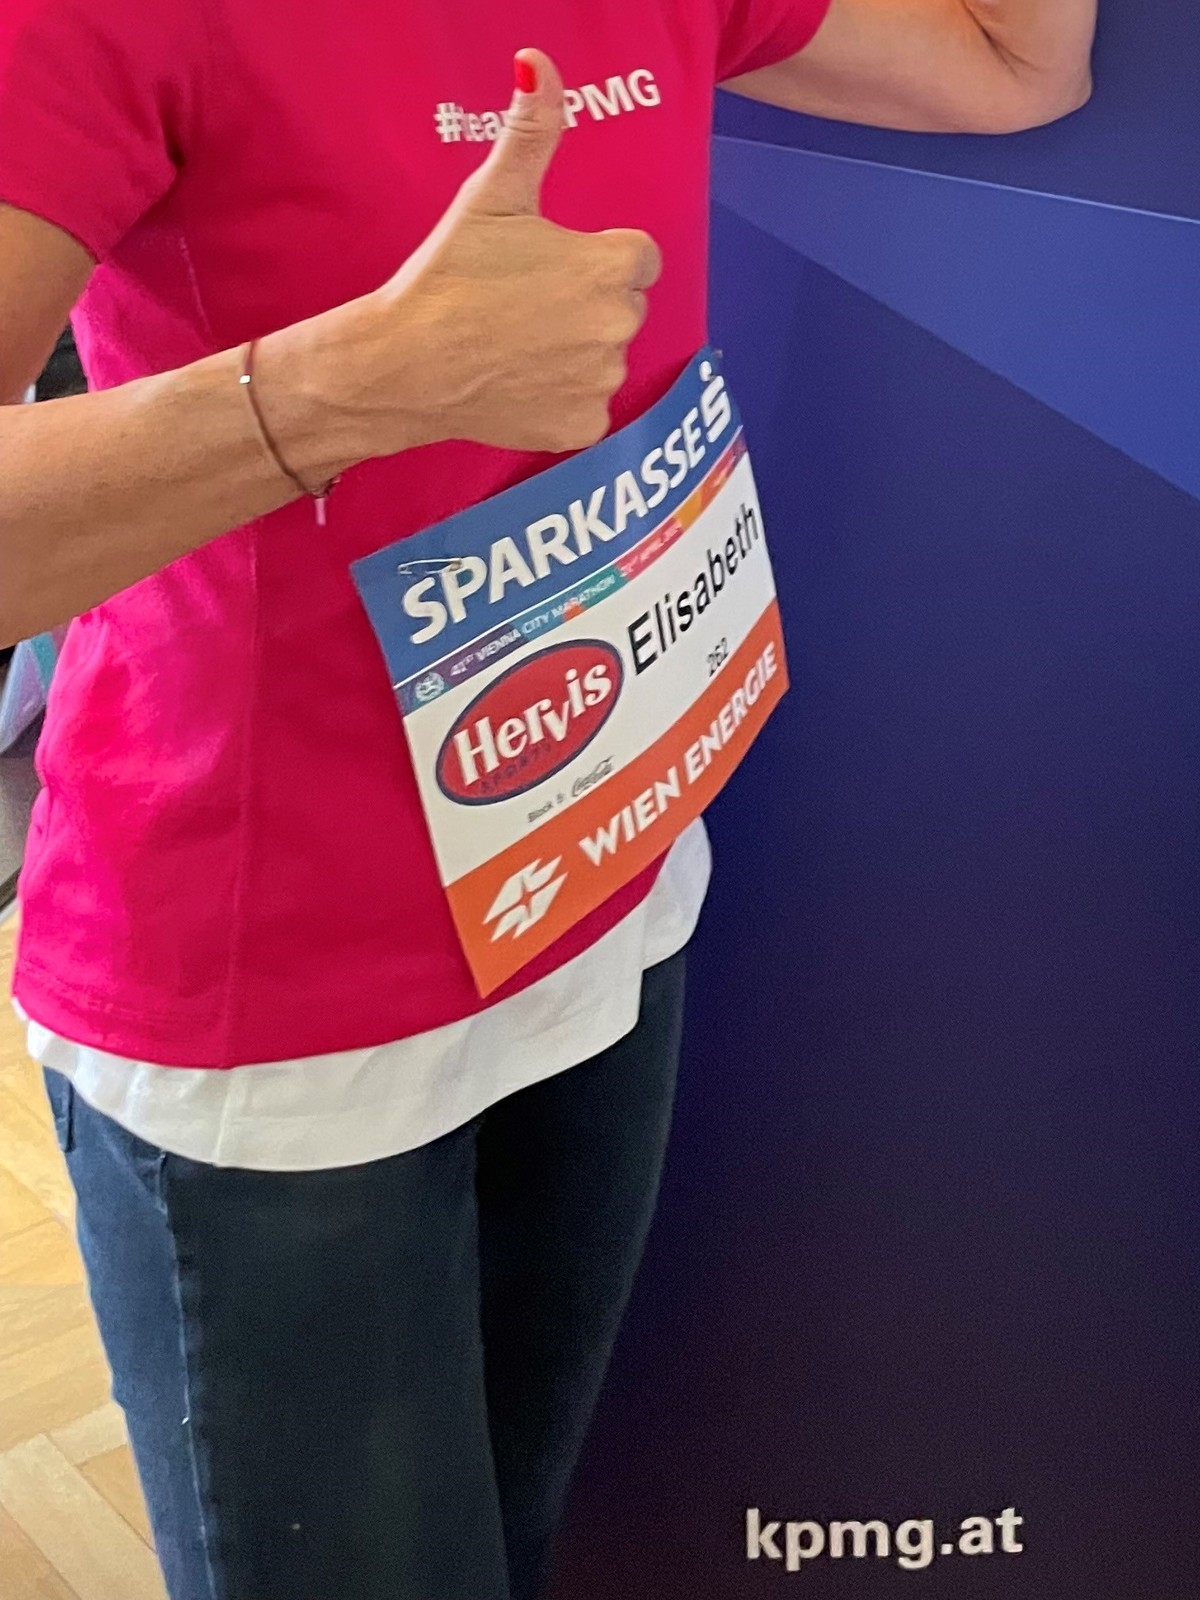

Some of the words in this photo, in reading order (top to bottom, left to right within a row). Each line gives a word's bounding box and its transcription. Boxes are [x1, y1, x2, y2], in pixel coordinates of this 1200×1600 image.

[402, 405, 706, 644] SPARKASSE
[627, 502, 759, 675] Elisabeth
[474, 628, 522, 661] VIENNA
[522, 613, 550, 635] CITY
[552, 574, 616, 619] MARATHON
[453, 663, 613, 787] Hervis
[579, 769, 682, 867] WIEN
[683, 639, 778, 785] ENERGIE
[745, 1507, 1024, 1572] kpmg.at
